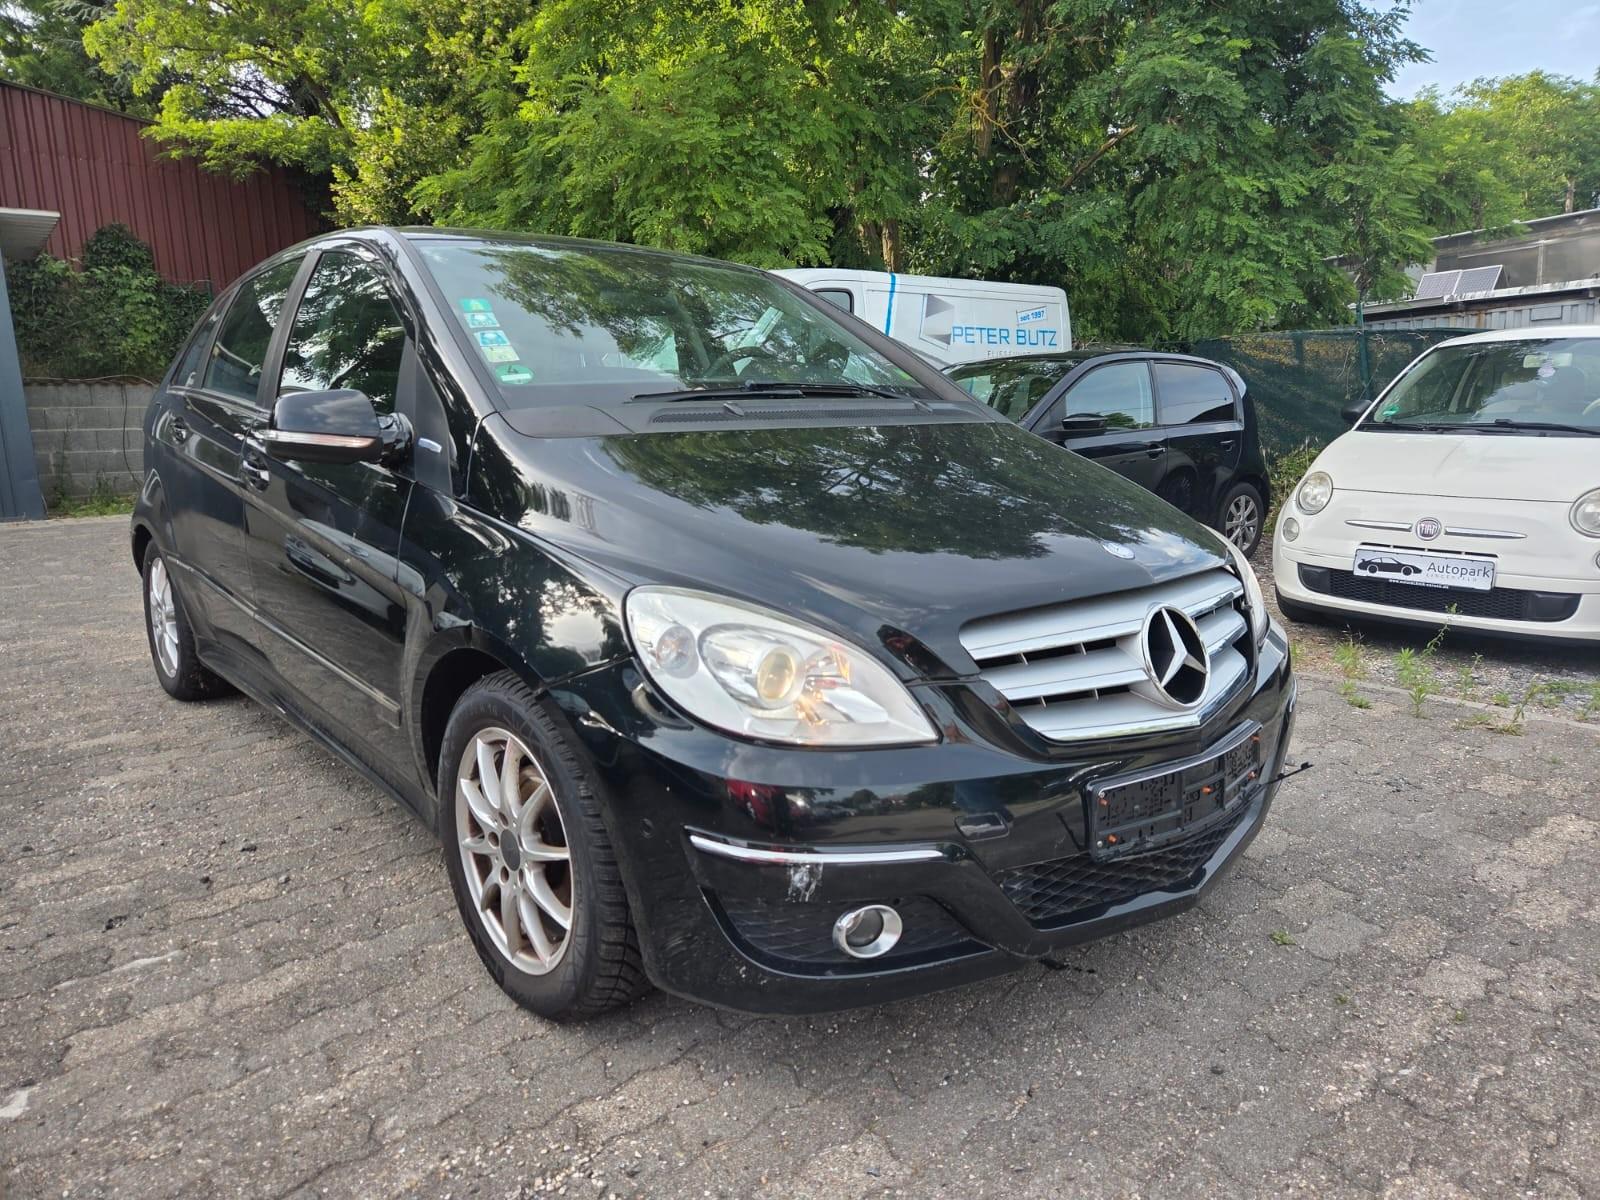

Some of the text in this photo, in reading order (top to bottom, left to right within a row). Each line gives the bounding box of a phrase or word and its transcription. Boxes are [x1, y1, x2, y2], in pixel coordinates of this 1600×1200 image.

[952, 326, 1057, 346] PETER BUTZ
[1427, 562, 1490, 578] Autopark
